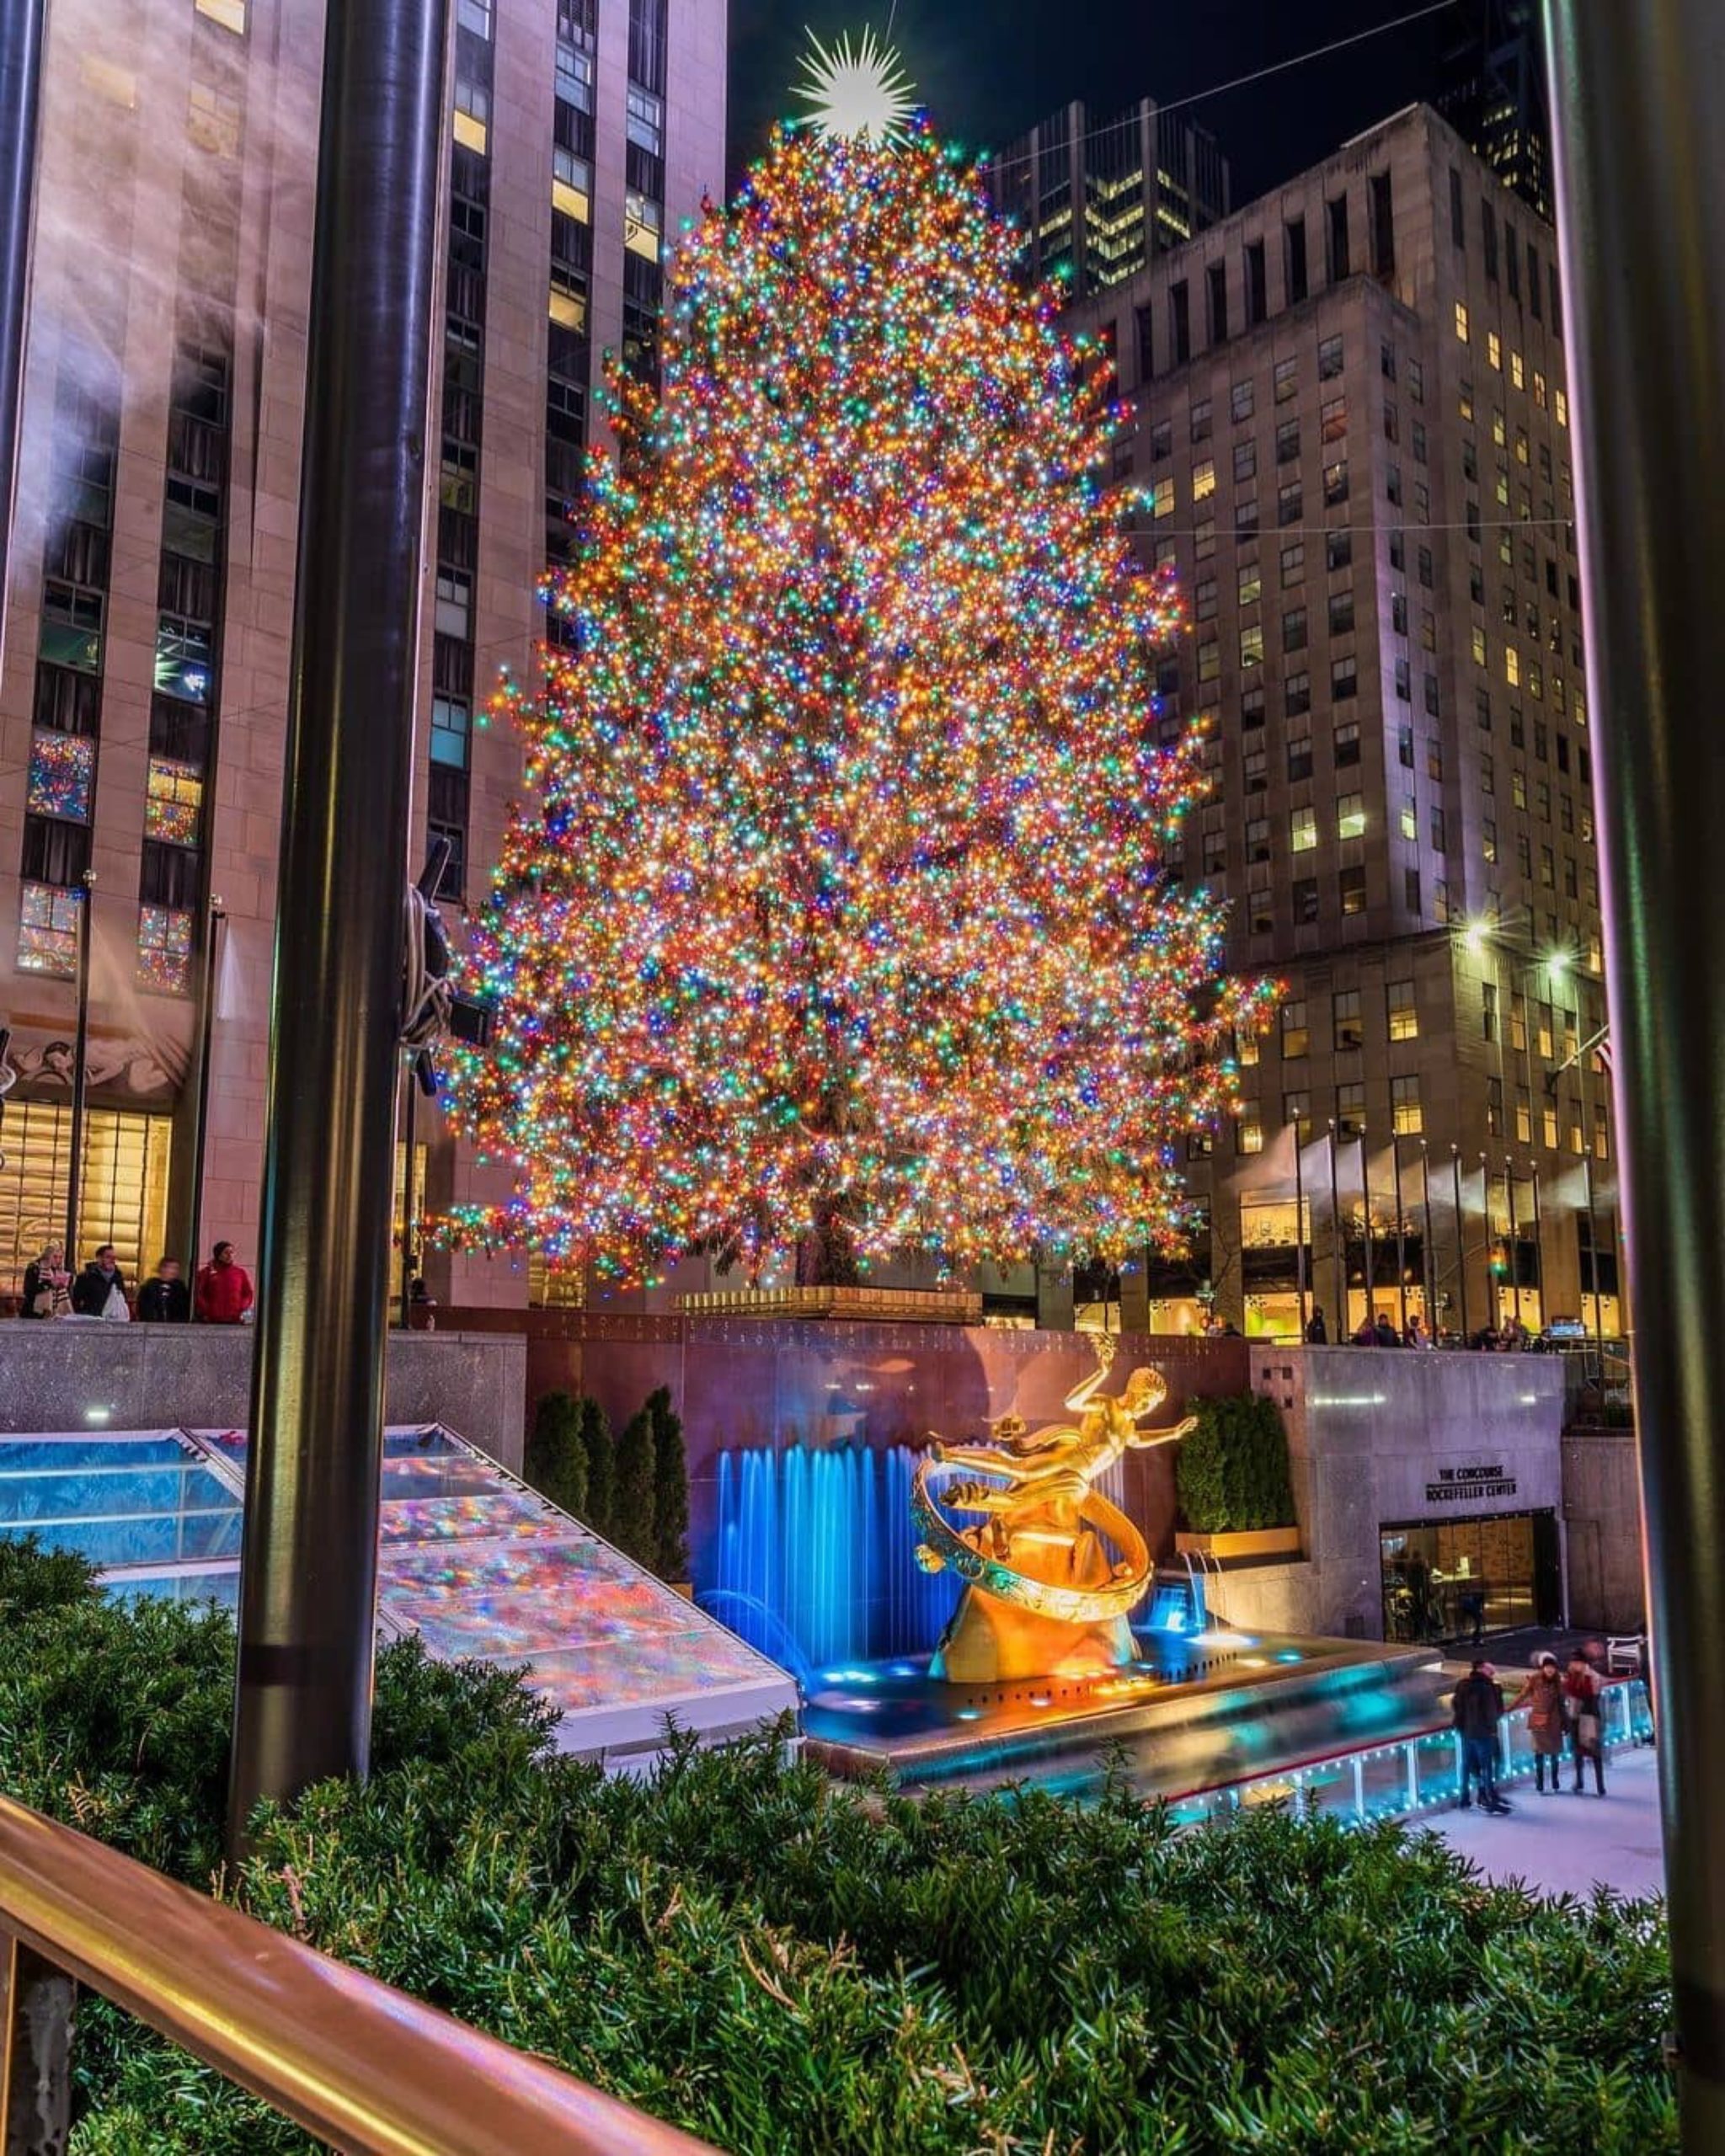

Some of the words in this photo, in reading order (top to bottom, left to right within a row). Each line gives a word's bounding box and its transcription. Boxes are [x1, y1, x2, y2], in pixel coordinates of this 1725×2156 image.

[1439, 1469, 1455, 1481] THE
[1456, 1465, 1503, 1480] CONCOURSE
[1426, 1485, 1484, 1502] ROCKEFELLER
[1486, 1483, 1516, 1497] CENTER
